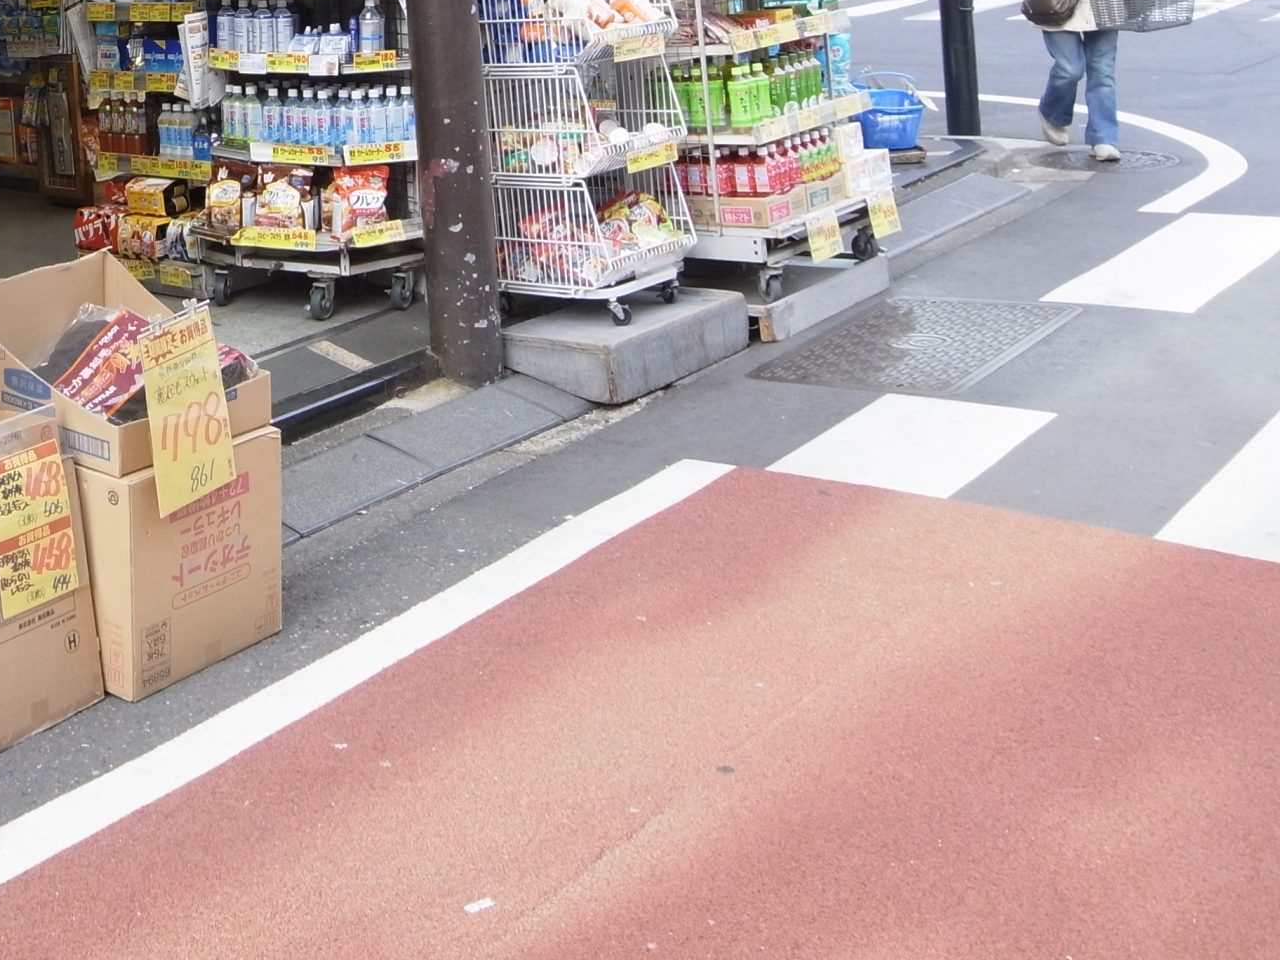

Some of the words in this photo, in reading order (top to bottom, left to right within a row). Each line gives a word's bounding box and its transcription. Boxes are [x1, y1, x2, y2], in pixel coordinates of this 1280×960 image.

[179, 318, 208, 344] お買得品
[3, 450, 38, 471] お買得品
[191, 458, 215, 492] 861
[180, 500, 241, 535] レギュラー
[19, 525, 51, 546] お買得品
[171, 535, 251, 587] デオシート
[67, 633, 77, 650] H
